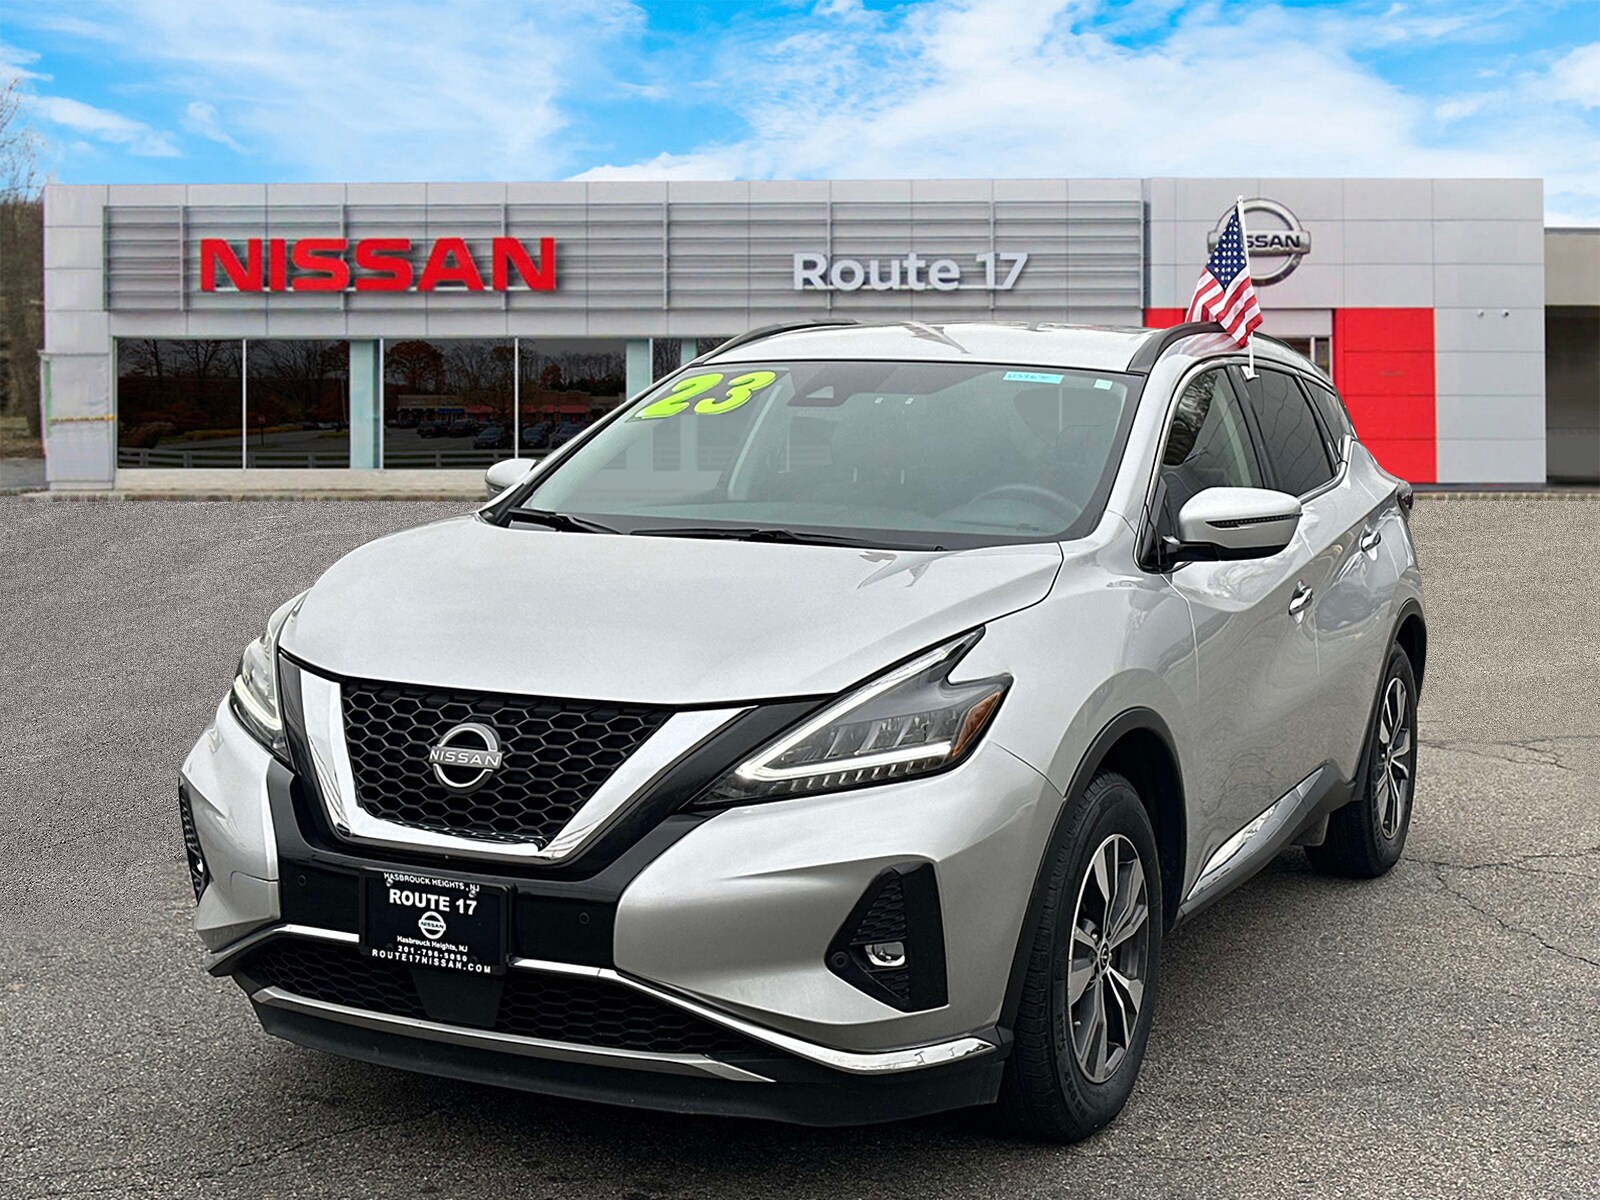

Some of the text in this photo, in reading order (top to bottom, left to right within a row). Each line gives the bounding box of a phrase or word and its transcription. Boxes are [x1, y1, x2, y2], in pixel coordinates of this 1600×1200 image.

[1246, 234, 1301, 249] SSAN
[200, 237, 555, 292] NISSAN
[793, 252, 1029, 291] Route 17
[634, 370, 777, 419] 23
[429, 749, 500, 767] NISSAN
[383, 872, 431, 886] HASBROUCK
[469, 884, 480, 893] NJ
[389, 888, 478, 915] ROUTE 17
[420, 921, 444, 930] NISSAN
[396, 935, 431, 948] Hasbrouck
[458, 944, 469, 953] NJ
[371, 948, 492, 974] ROUTE17NISSAN.COM
